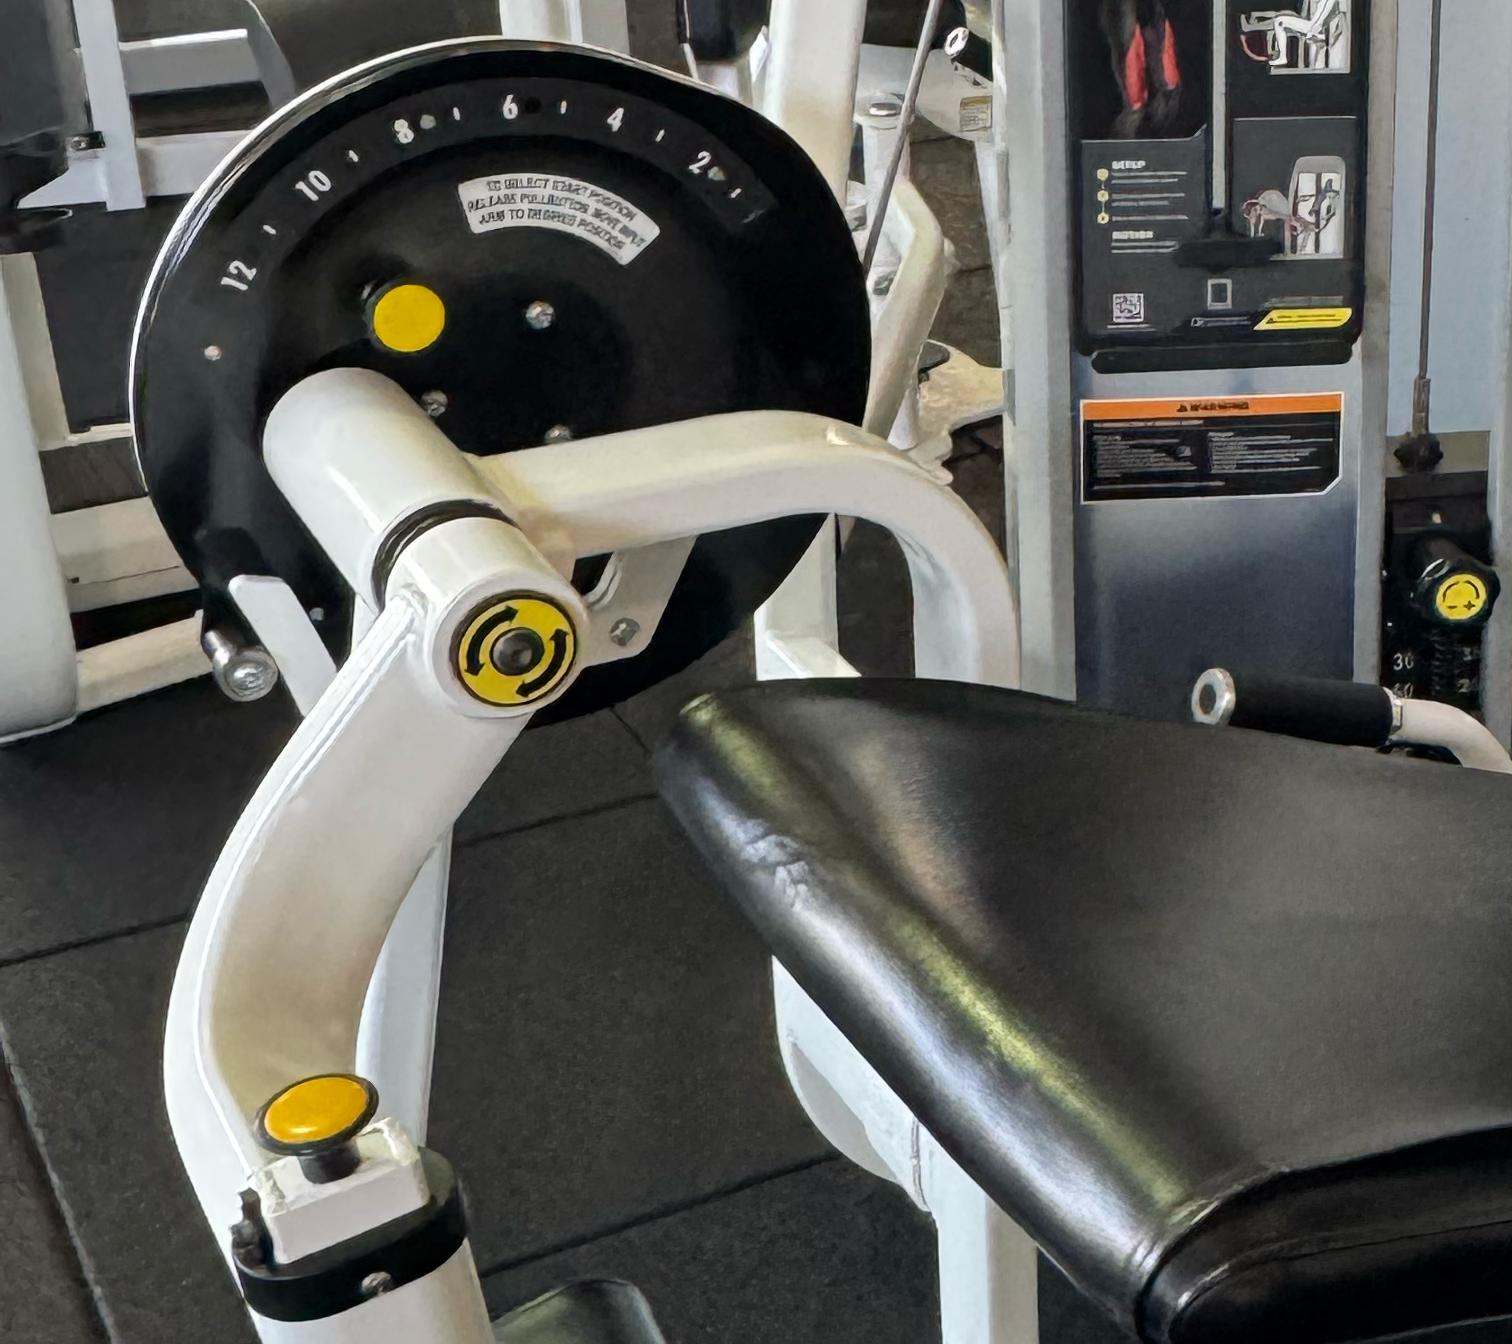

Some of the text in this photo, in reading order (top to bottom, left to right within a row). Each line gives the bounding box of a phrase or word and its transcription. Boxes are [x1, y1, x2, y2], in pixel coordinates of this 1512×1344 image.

[221, 94, 711, 291] 12 10 8 6 4 2
[509, 207, 525, 220] TO
